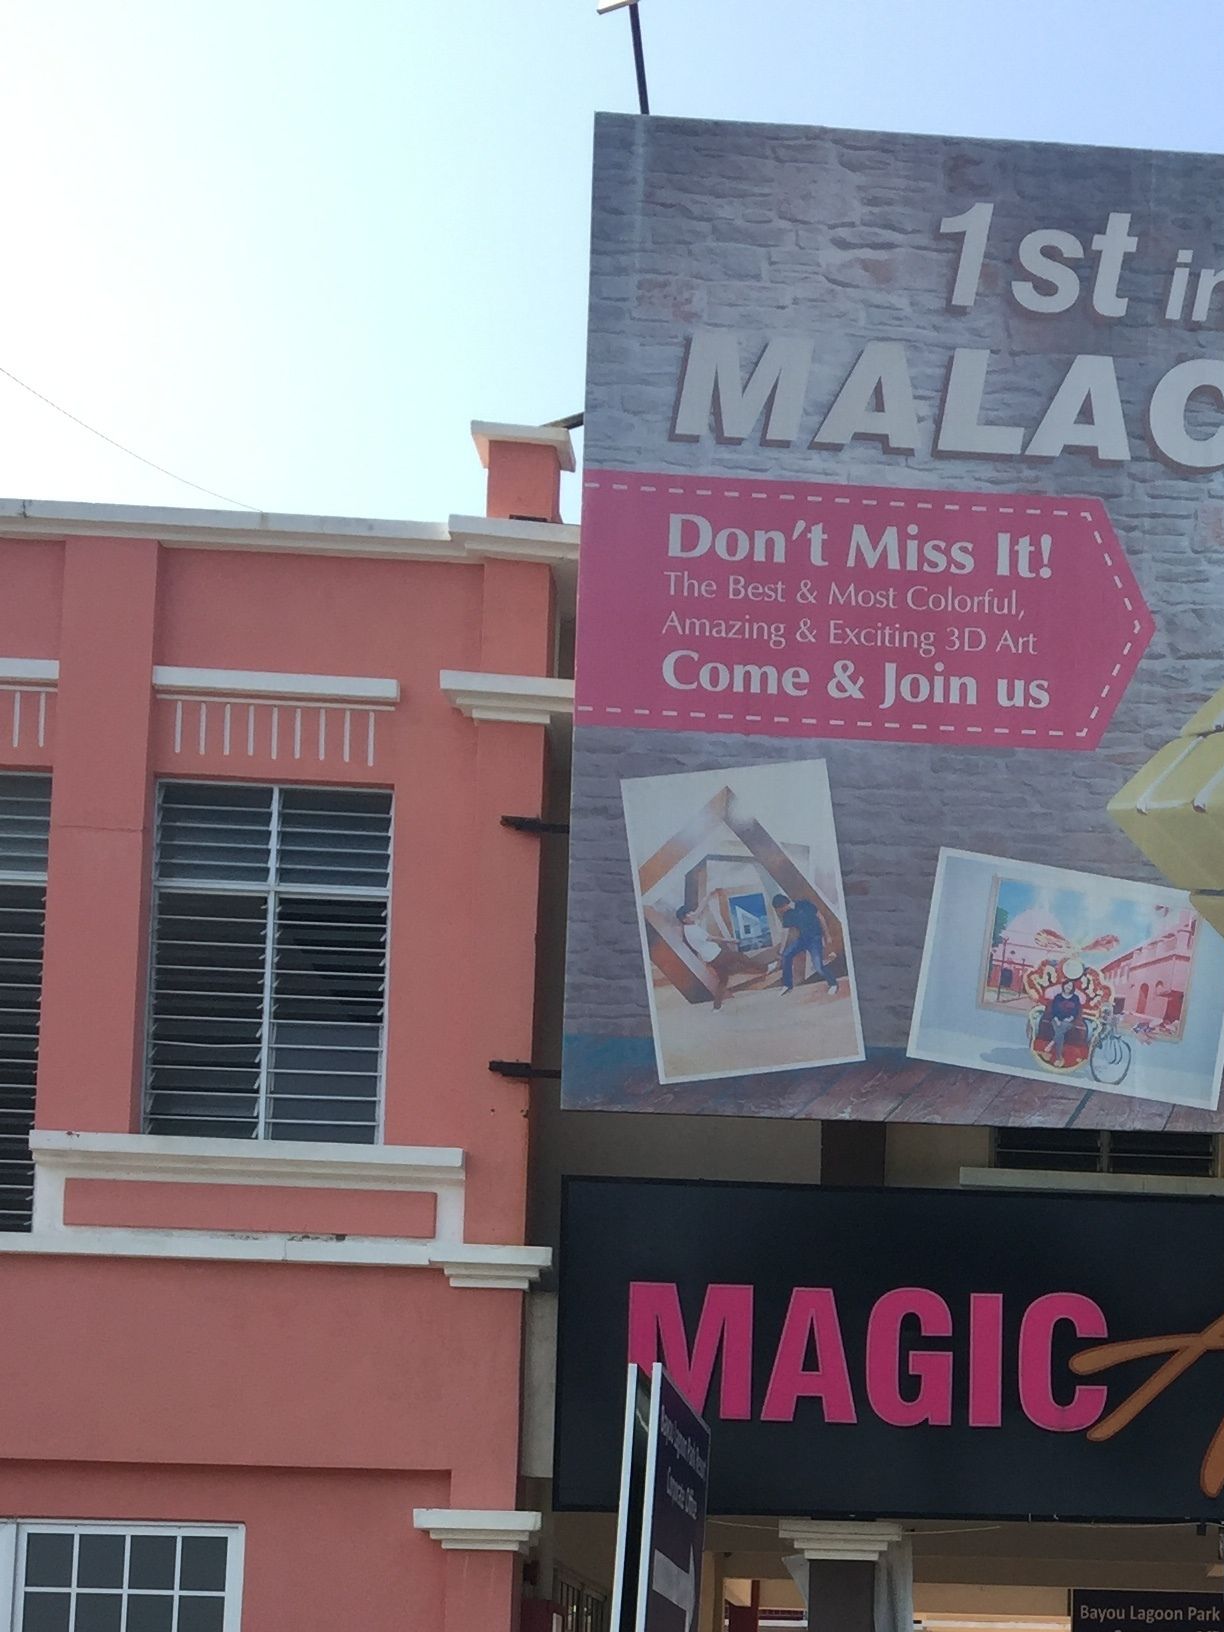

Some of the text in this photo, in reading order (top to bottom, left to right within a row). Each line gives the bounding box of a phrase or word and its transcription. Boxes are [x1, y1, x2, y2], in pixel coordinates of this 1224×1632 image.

[937, 202, 1138, 320] 1st
[666, 513, 1054, 579] Don't Miss It!
[663, 570, 1026, 619] The Best & Most Colorful,
[662, 610, 1037, 656] Amazing & Exciting 3D Art
[661, 650, 1050, 709] Come & Join us
[628, 1281, 1108, 1431] MAGIC
[1080, 1605, 1125, 1623] Bayou
[1130, 1606, 1183, 1624] Lagoon
[1188, 1606, 1221, 1622] Park
